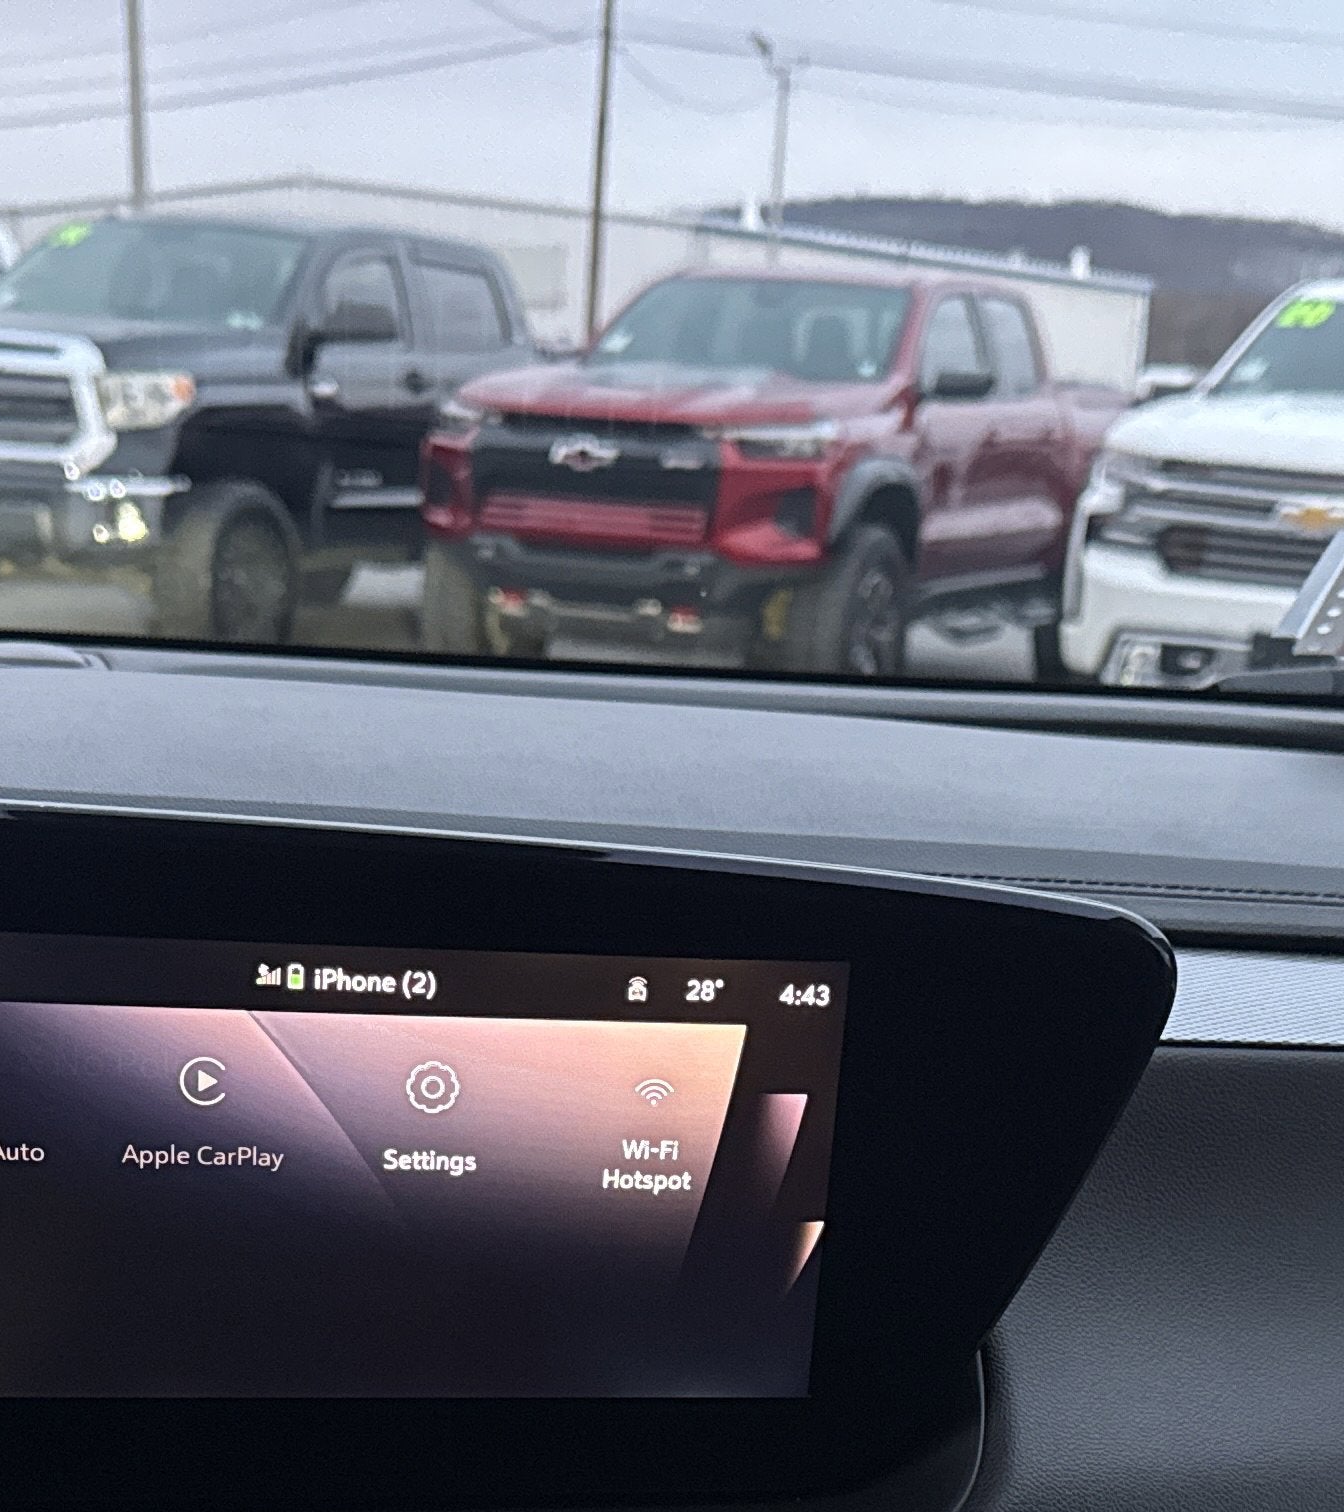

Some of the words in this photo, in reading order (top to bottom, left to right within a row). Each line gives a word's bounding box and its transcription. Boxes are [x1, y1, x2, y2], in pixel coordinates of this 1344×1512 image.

[313, 967, 397, 995] iPhone
[402, 970, 437, 999] (2)
[685, 978, 724, 1002] 28°
[778, 983, 830, 1007] 4:43
[121, 1143, 190, 1171] Apple
[196, 1145, 285, 1172] CarPlay
[382, 1148, 477, 1176] Settings
[622, 1138, 679, 1162] Wi-Fi
[601, 1168, 692, 1195] Hotspot
